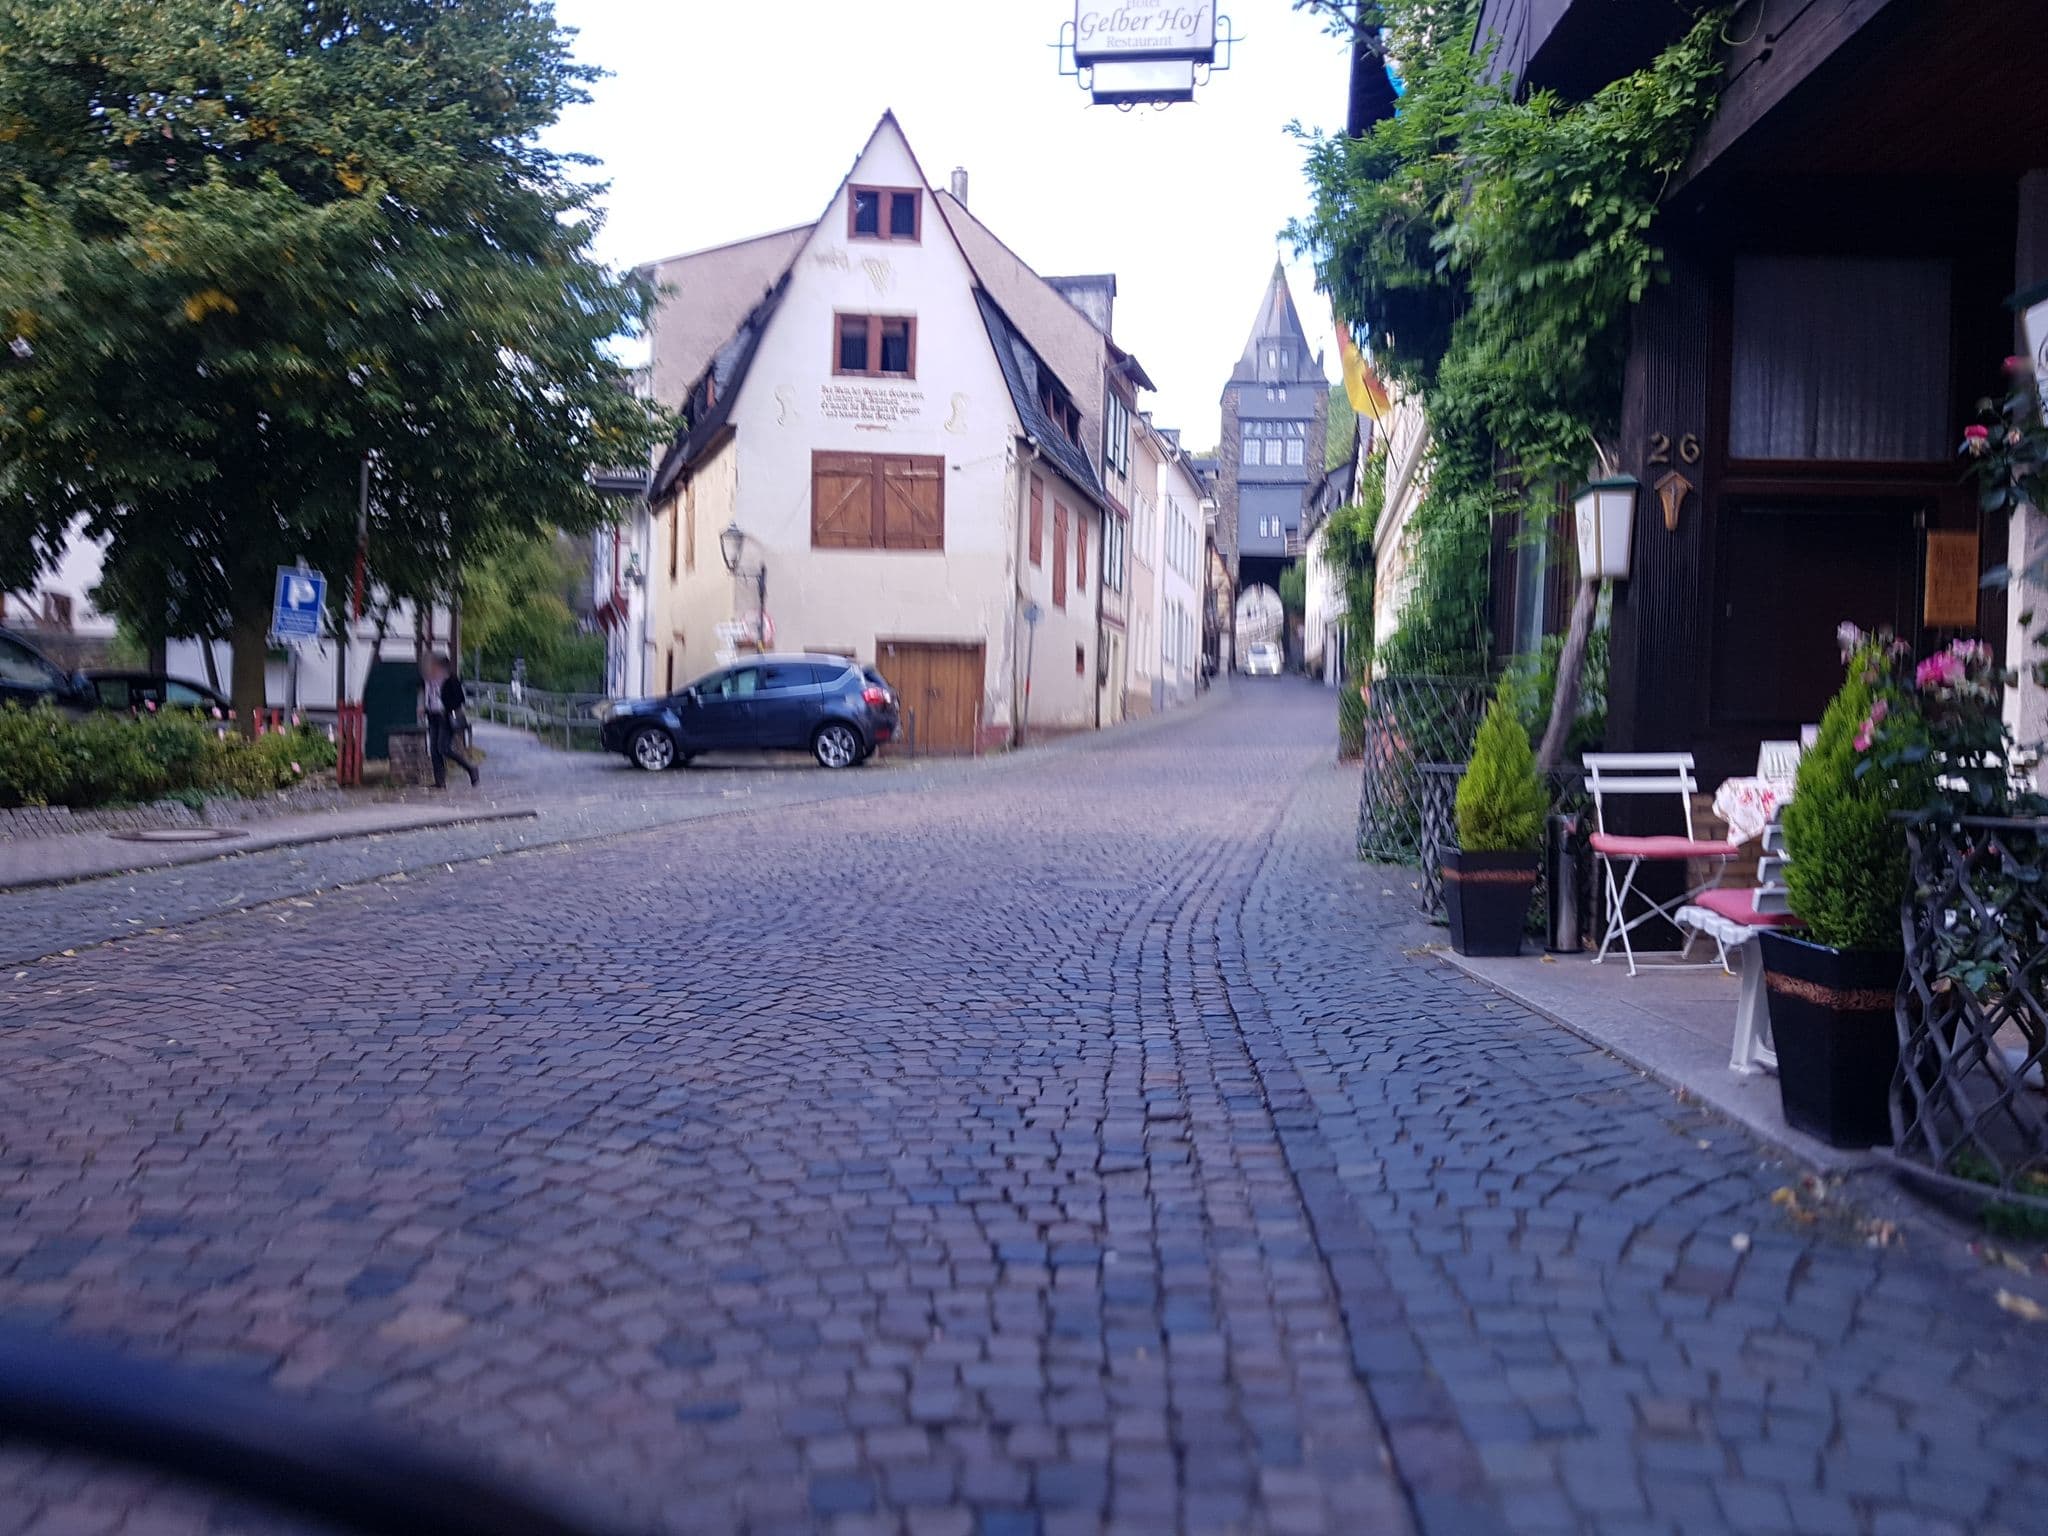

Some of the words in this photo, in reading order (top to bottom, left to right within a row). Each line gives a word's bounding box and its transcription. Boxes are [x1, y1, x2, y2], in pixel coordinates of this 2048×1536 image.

[1080, 7, 1153, 41] Gelber
[1155, 5, 1208, 37] Hof
[1105, 35, 1173, 48] Restaurant
[1648, 432, 1700, 464] 26
[288, 577, 316, 611] P
